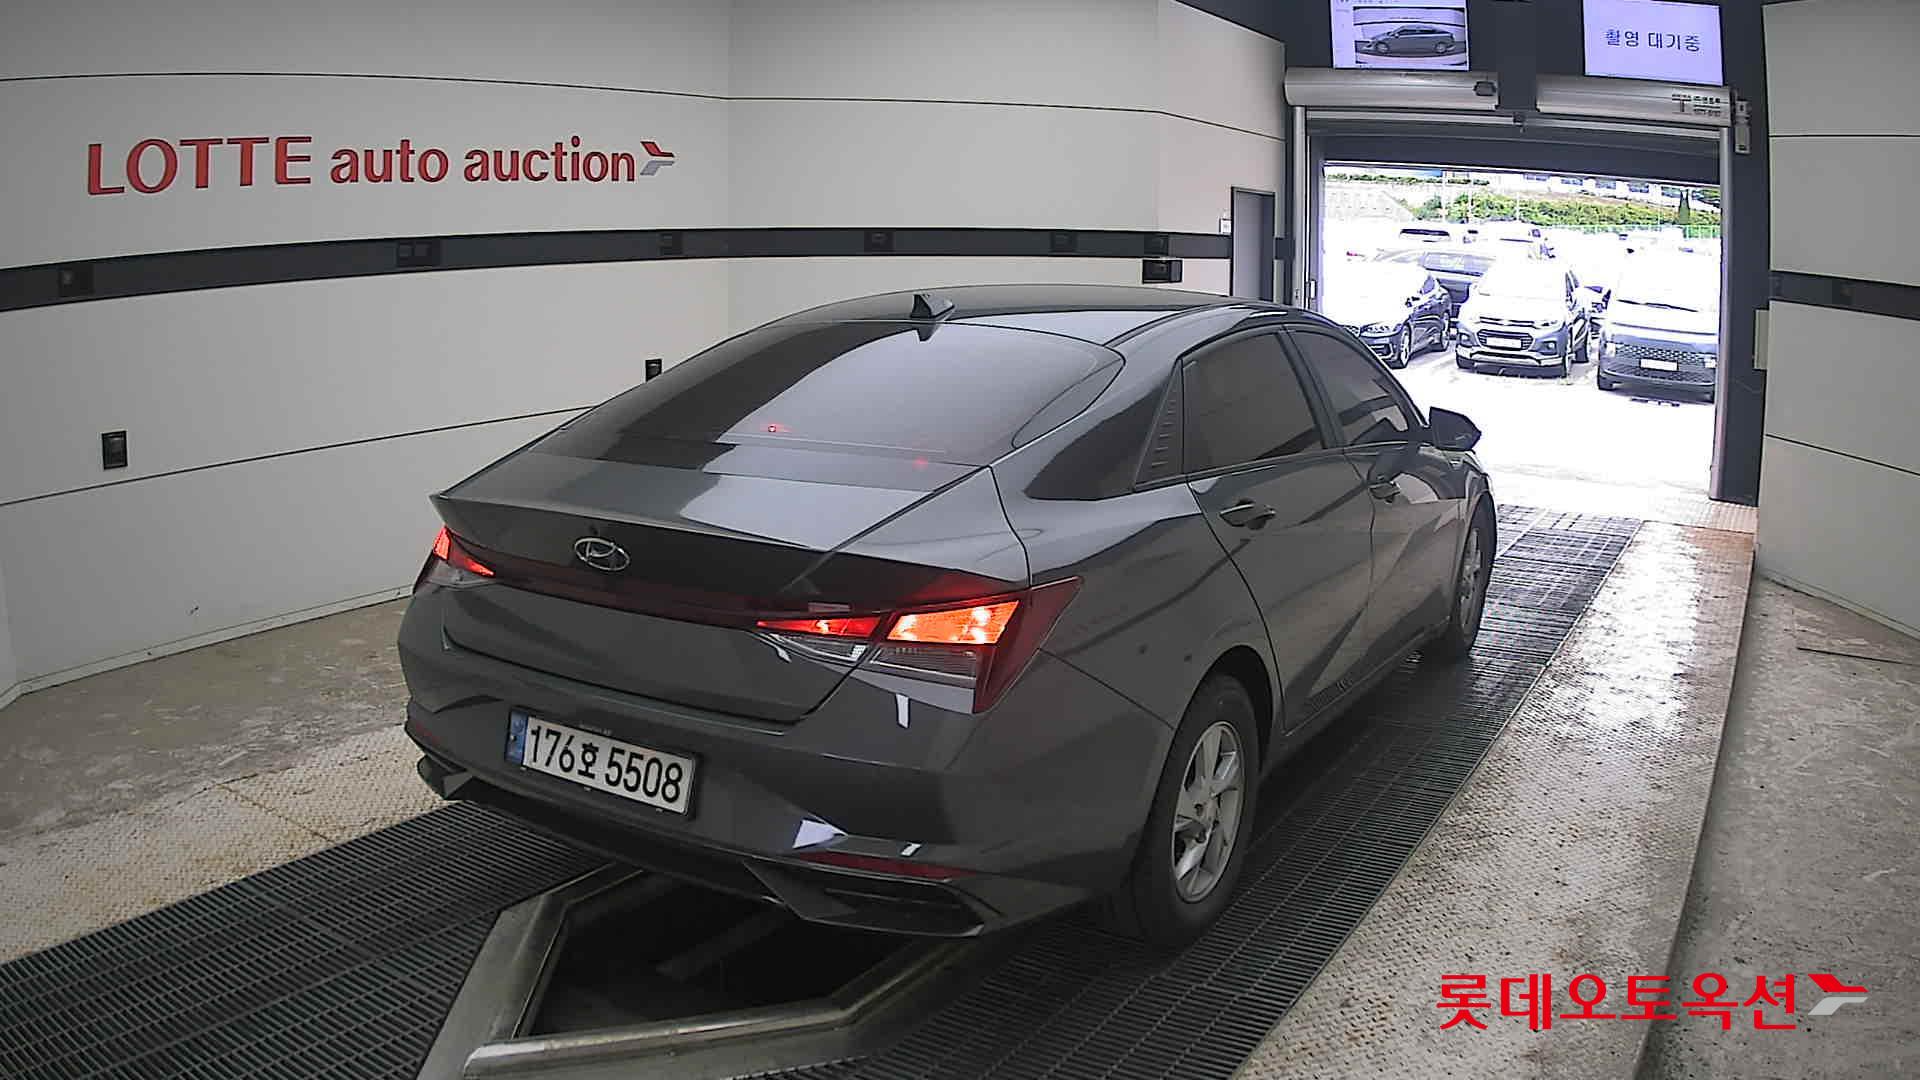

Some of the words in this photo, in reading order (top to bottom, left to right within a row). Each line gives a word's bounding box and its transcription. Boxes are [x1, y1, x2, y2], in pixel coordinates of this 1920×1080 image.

[1605, 28, 1640, 48] 촬영
[1647, 31, 1701, 53] 대기중
[87, 135, 312, 196] LOTTE
[329, 138, 450, 185] auto
[463, 135, 636, 184] auction
[530, 724, 600, 780] 176호
[604, 746, 684, 804] 5508
